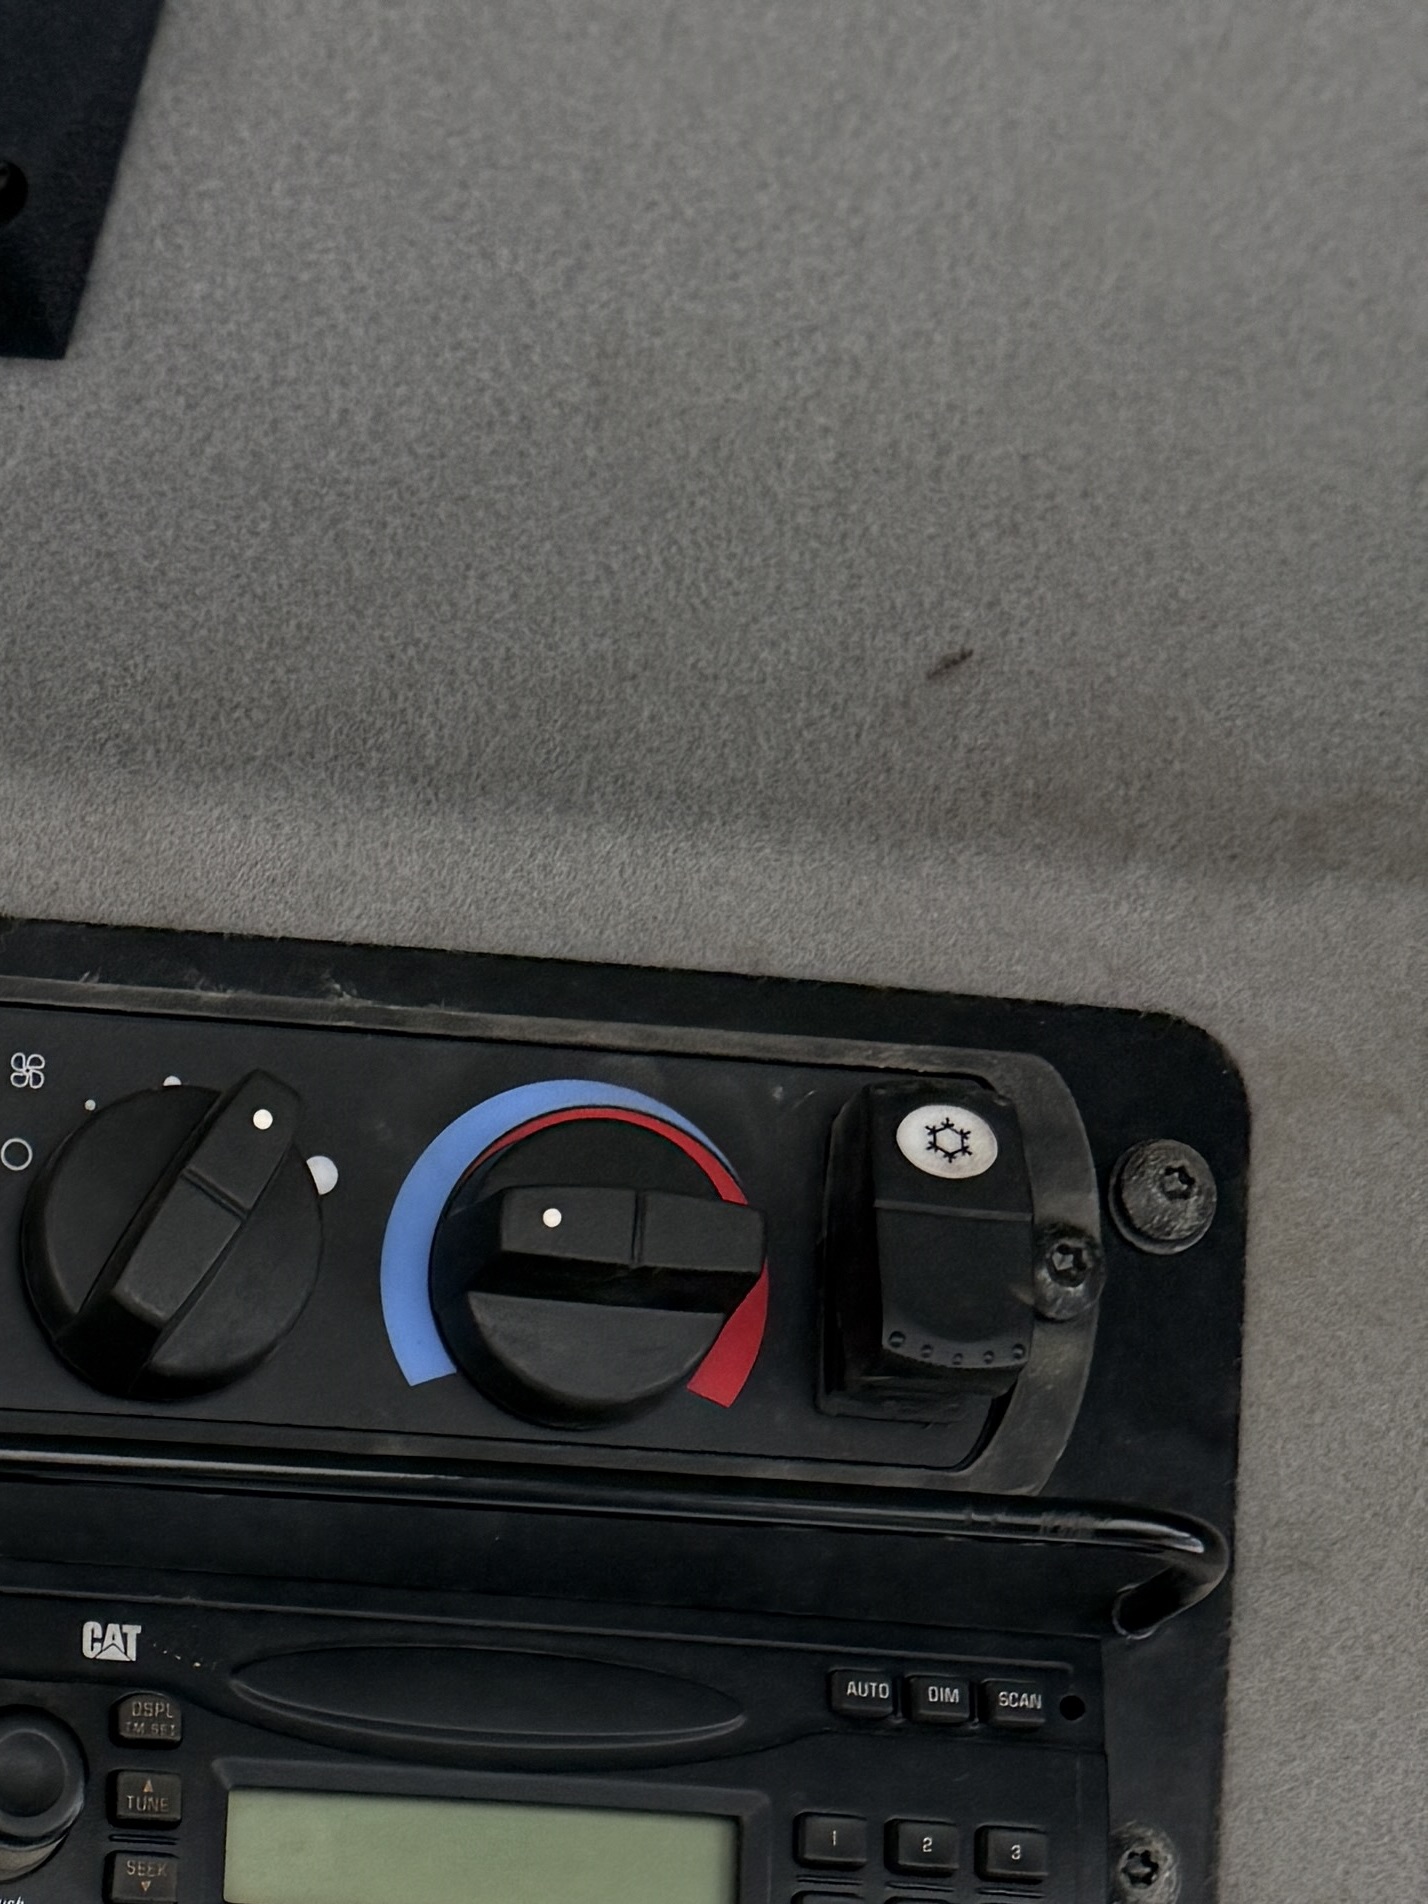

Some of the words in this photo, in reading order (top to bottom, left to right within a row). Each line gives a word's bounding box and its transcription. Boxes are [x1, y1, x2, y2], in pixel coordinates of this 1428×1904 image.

[81, 1620, 142, 1662] CAT
[846, 1680, 890, 1699] AUTO
[928, 1686, 960, 1703] DIM
[998, 1691, 1042, 1709] SCAN
[131, 1701, 174, 1719] DSPL
[126, 1795, 170, 1813] TUNE
[831, 1830, 837, 1846] 1
[922, 1837, 933, 1853] 2
[1010, 1844, 1022, 1860] 3
[126, 1859, 168, 1878] SEEK
